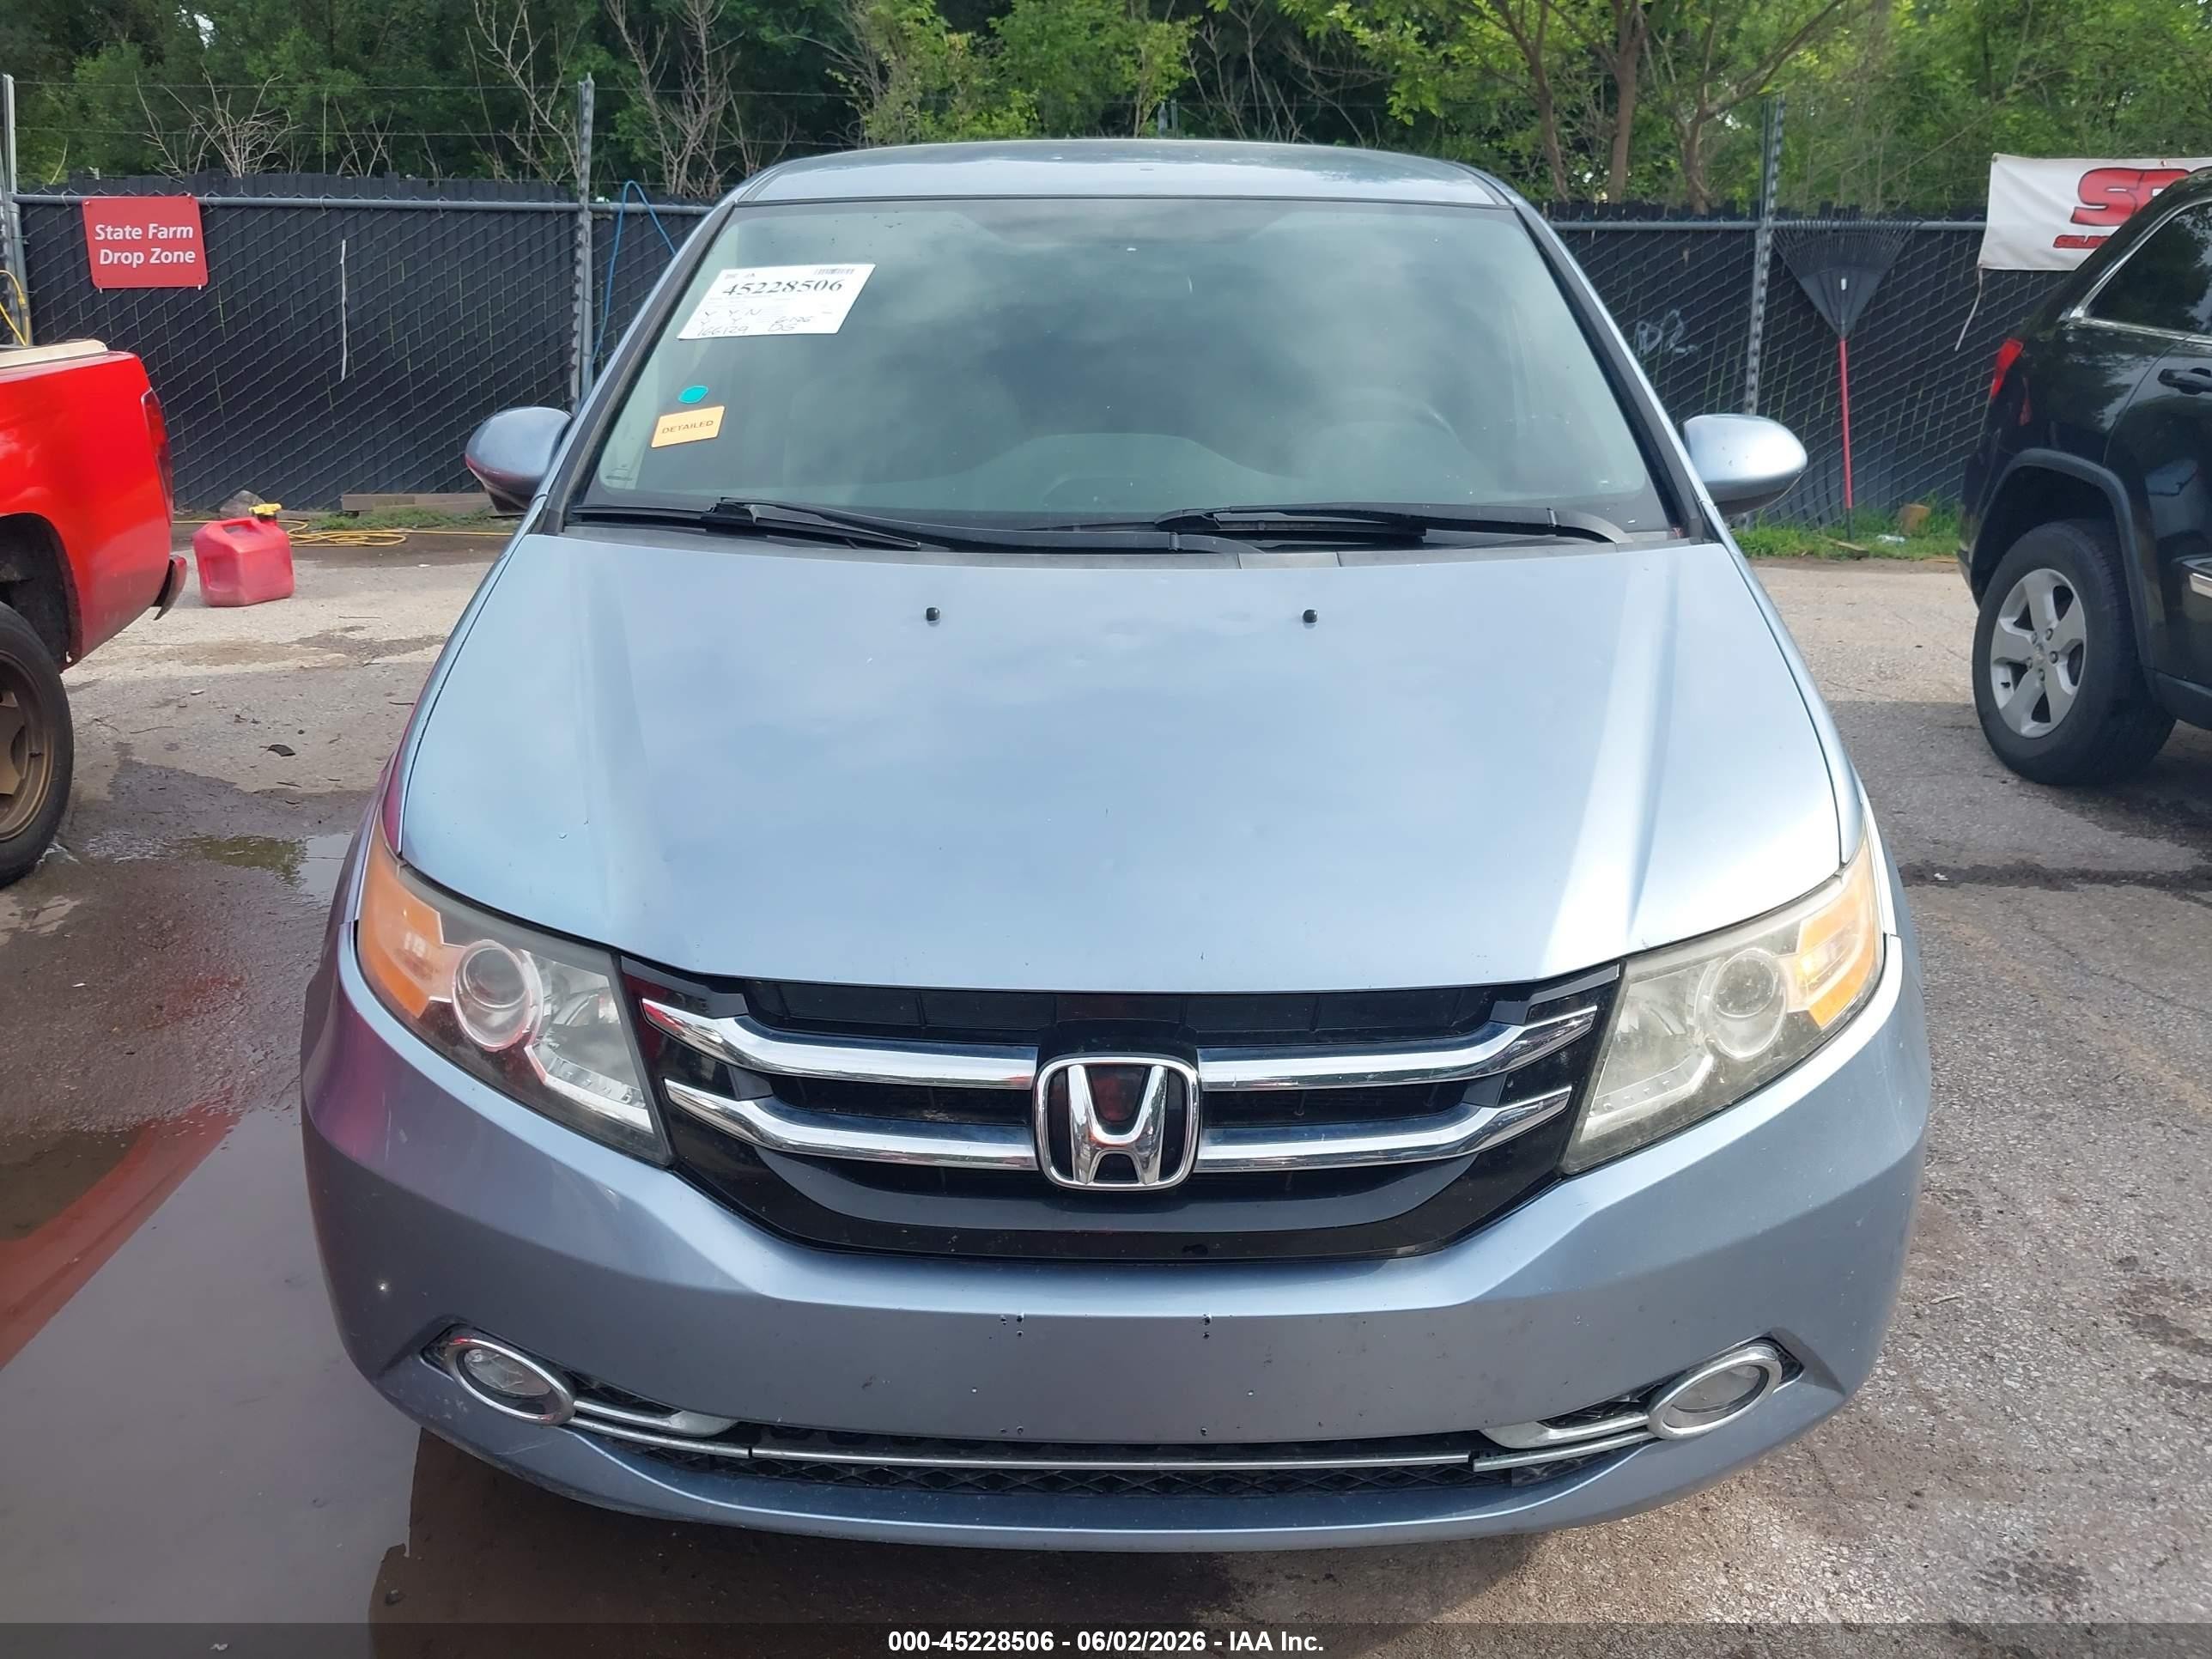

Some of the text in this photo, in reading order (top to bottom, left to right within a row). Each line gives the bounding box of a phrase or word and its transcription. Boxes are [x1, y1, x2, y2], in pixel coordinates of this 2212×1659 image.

[94, 223, 193, 240] State Farm
[99, 247, 196, 268] Drop Zone
[722, 279, 845, 296] 45228506
[661, 420, 714, 434] DETAILED
